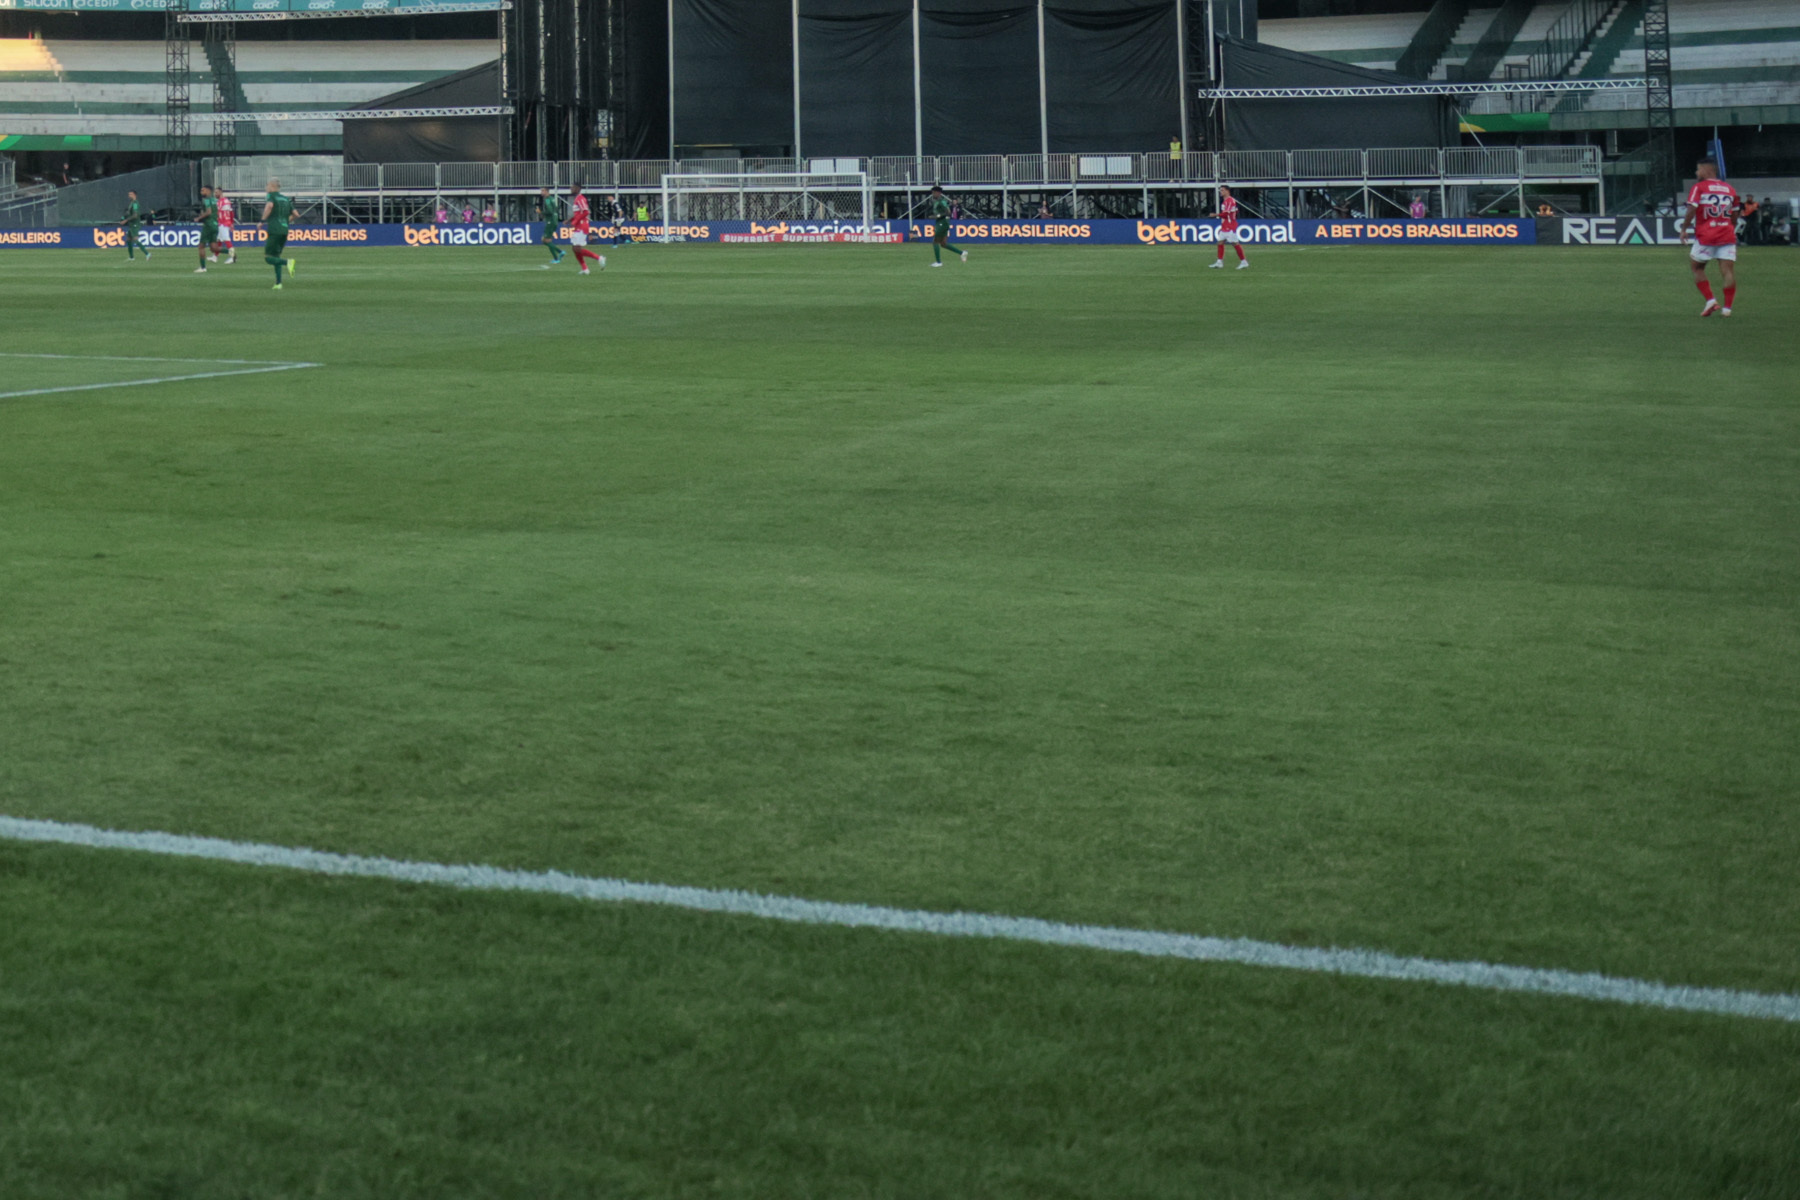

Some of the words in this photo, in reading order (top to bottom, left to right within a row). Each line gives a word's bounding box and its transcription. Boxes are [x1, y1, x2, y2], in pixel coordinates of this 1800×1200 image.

[87, 0, 119, 7] CEDIP
[1708, 194, 1733, 217] 32
[232, 229, 256, 241] BET
[287, 229, 367, 241] BRASILEIROS
[404, 223, 532, 246] betnacional
[955, 224, 989, 237] DOS
[991, 224, 1091, 238] BRASILEIROS
[1315, 224, 1328, 238] A
[1330, 224, 1363, 238] BET
[1366, 223, 1403, 238] DOS
[1405, 223, 1518, 238] BRASILEIROS
[723, 234, 776, 243] SUPERBET
[782, 234, 836, 243] SUPERBET
